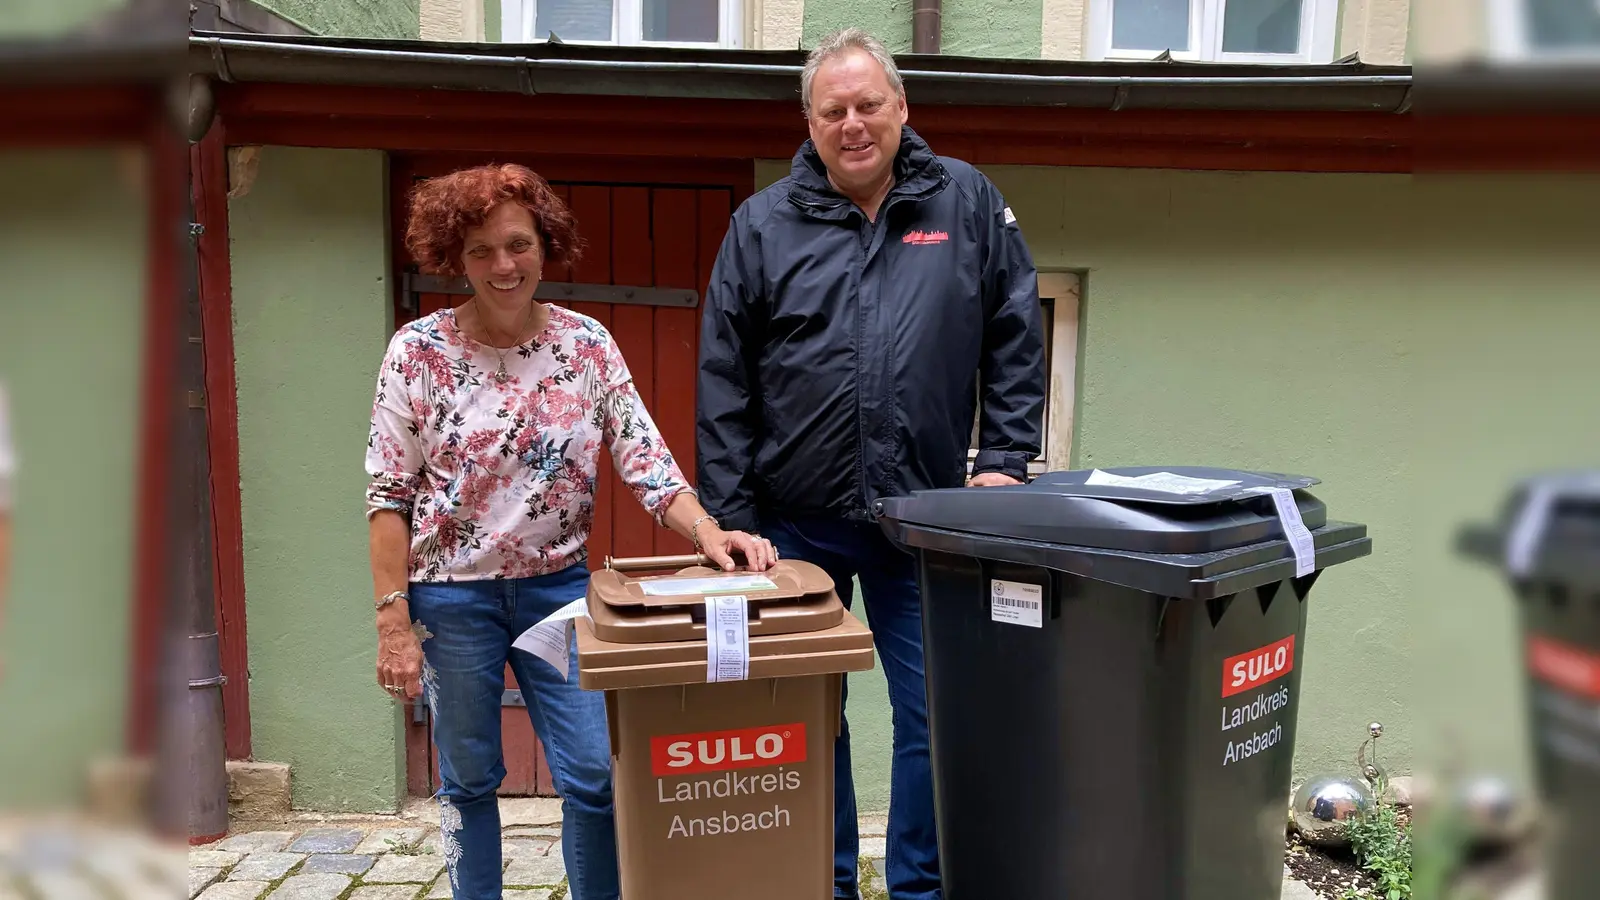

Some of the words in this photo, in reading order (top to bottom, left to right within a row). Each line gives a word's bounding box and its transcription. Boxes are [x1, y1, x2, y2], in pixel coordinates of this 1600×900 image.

[1232, 645, 1286, 687] SULO
[1222, 685, 1288, 731] Landkreis
[1223, 722, 1282, 766] Ansbach
[659, 767, 801, 803] Landkreis
[669, 805, 790, 838] Ansbach
